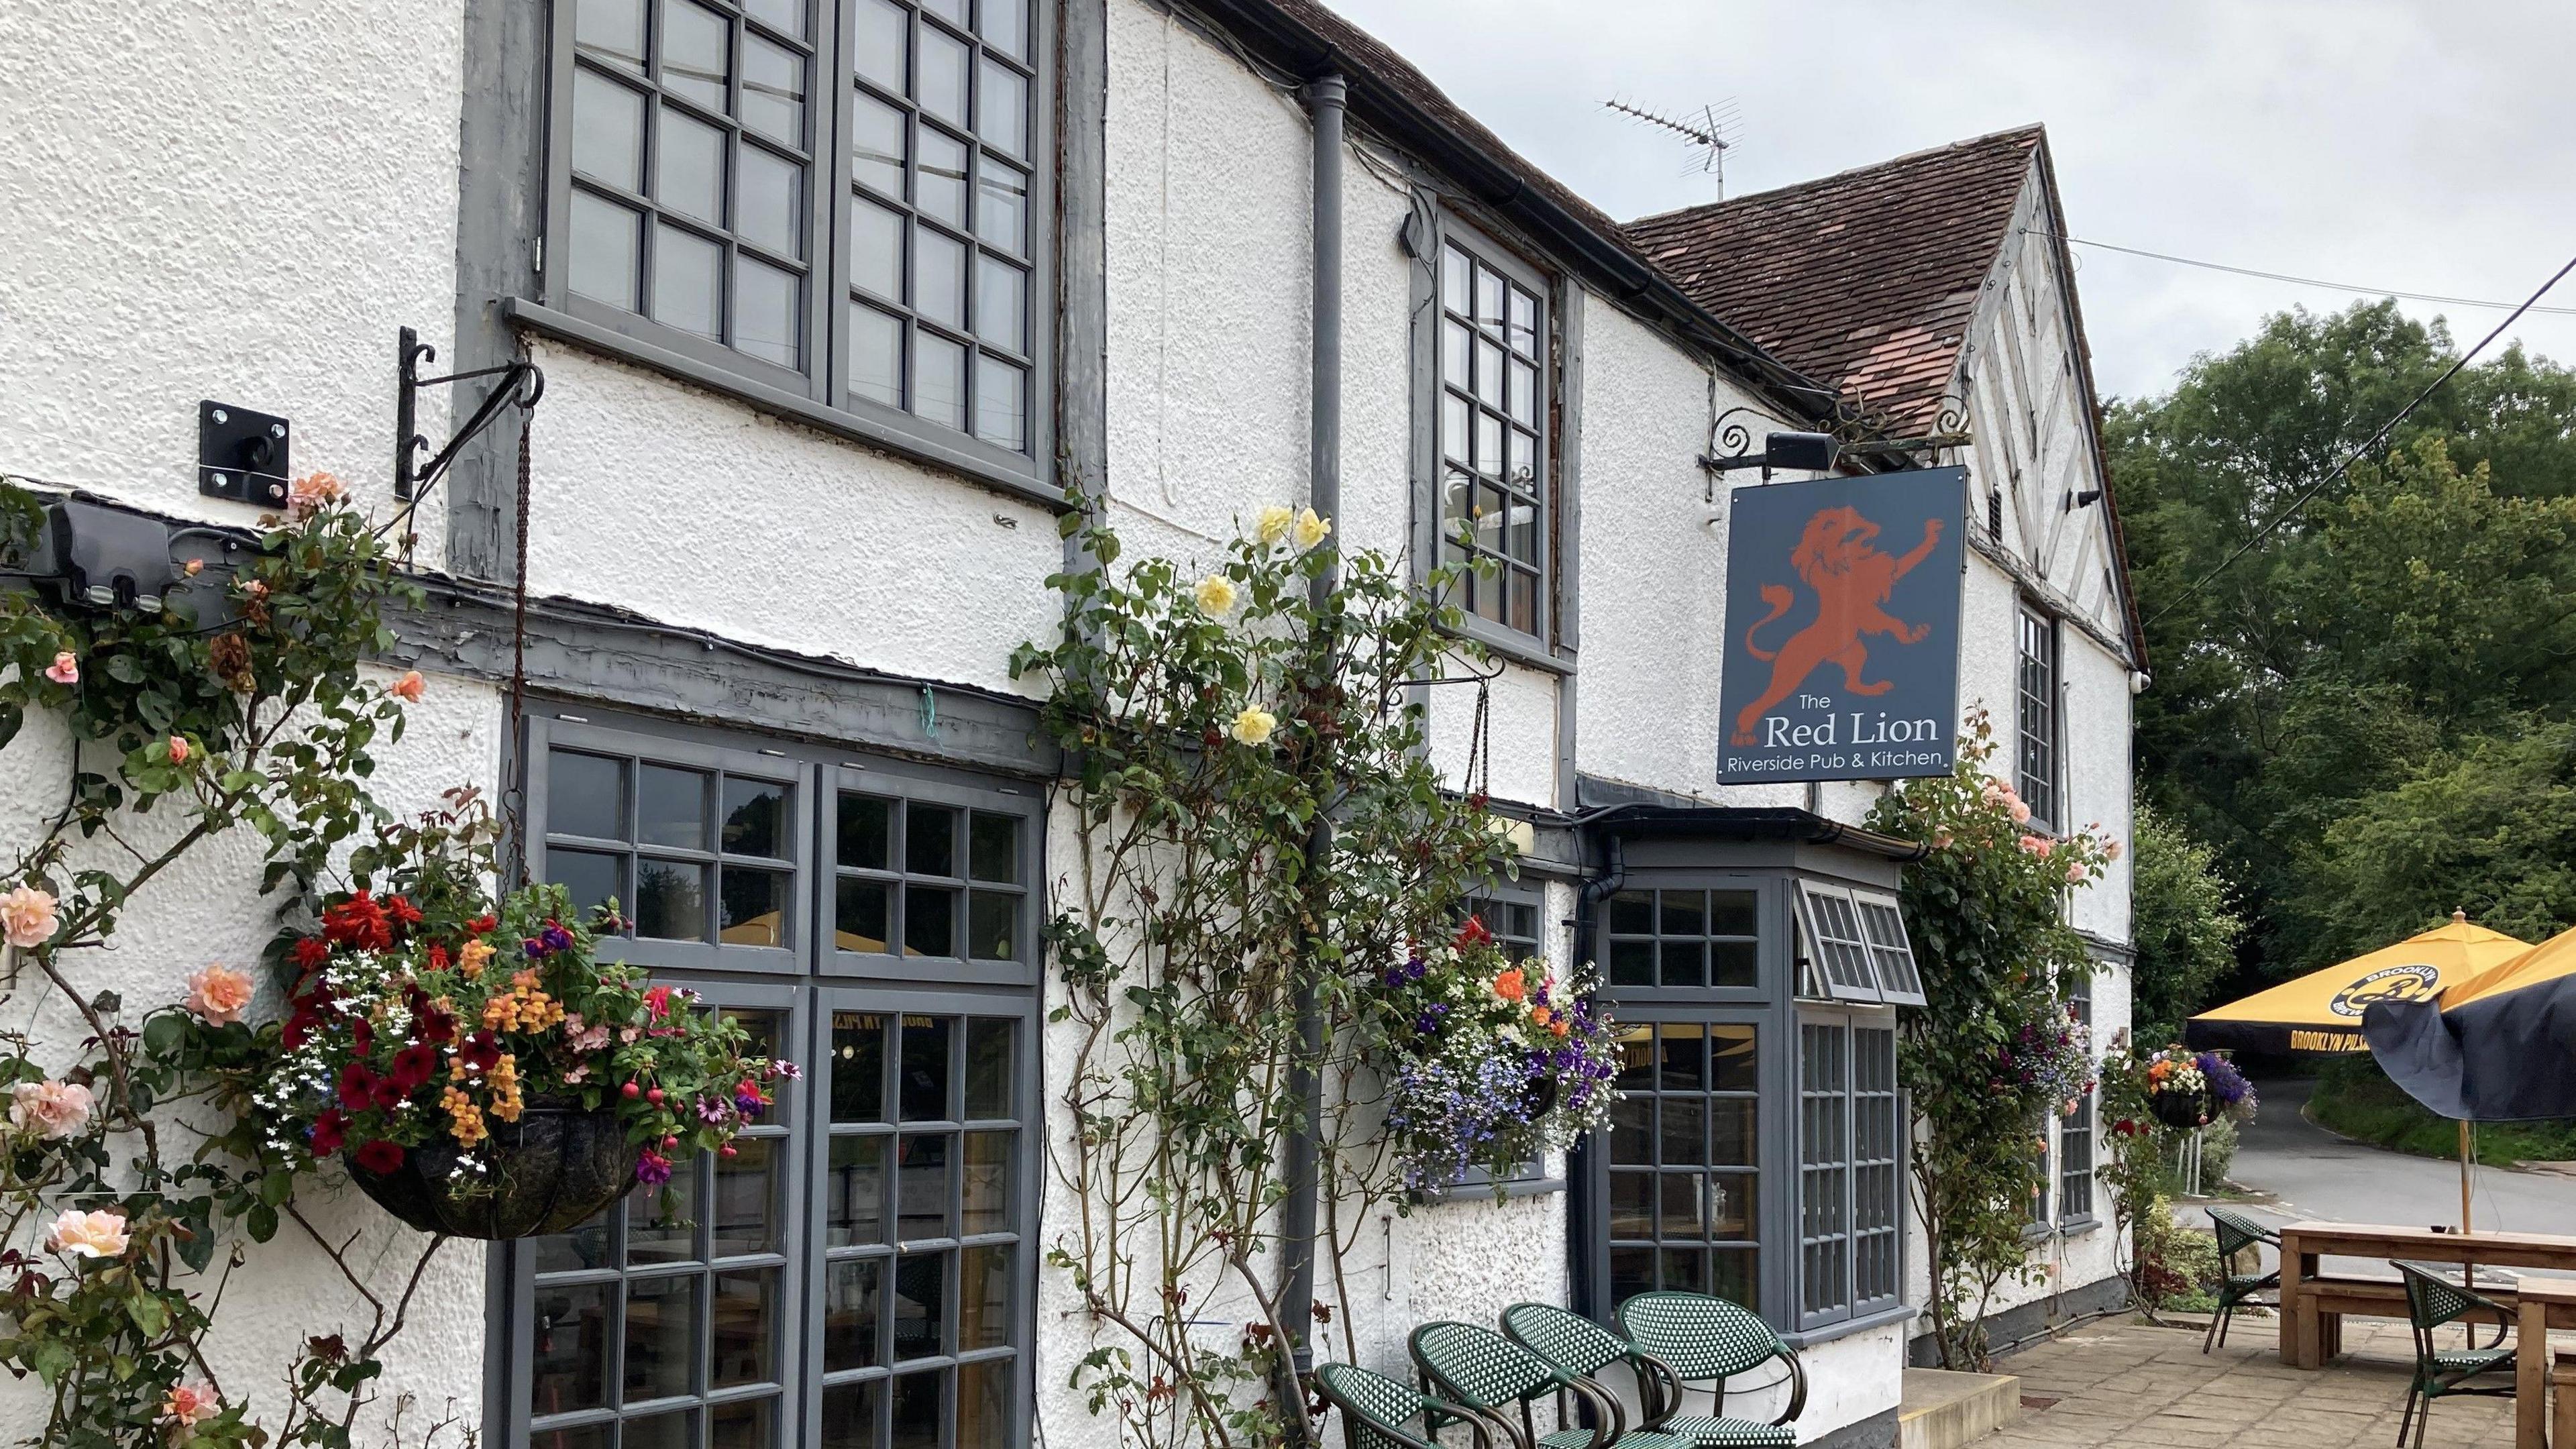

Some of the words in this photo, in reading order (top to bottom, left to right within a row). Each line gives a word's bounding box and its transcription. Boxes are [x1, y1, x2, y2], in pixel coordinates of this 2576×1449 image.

[1799, 694, 1831, 710] The
[1764, 712, 1837, 748] Red
[1850, 711, 1939, 744] Lion
[1727, 755, 1805, 772] Riverside
[1810, 753, 1845, 769] Pub
[1851, 753, 1864, 768] &
[1871, 750, 1941, 766] Kitchen
[2366, 966, 2436, 983] BROOKLYN
[2332, 1001, 2365, 1016] BREW
[2291, 1030, 2345, 1051] BROOKLYN
[2341, 1034, 2370, 1052] PILS
